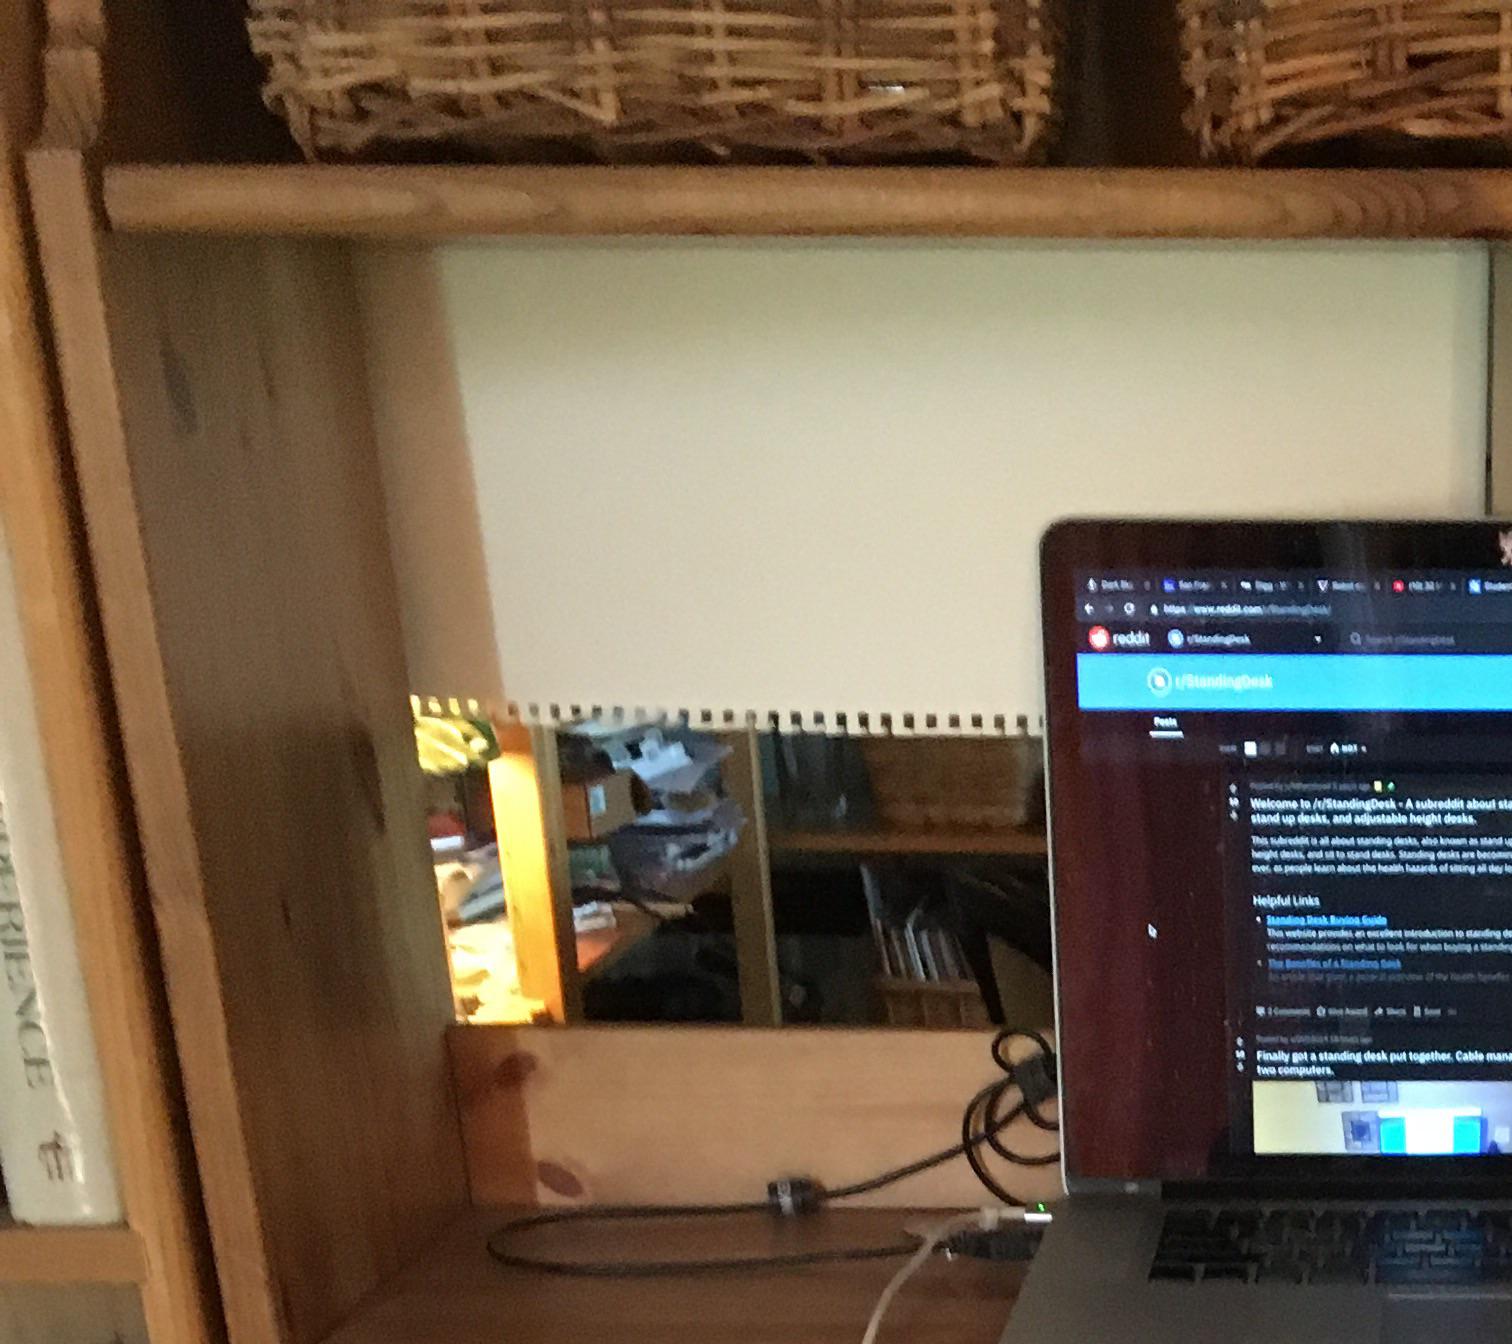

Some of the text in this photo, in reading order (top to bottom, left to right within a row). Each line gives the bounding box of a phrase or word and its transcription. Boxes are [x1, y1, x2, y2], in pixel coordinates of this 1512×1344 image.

[1112, 631, 1150, 646] reddit
[1175, 674, 1273, 691] r/StandingDesk
[1250, 798, 1299, 812] Welcome
[1300, 798, 1311, 812] to
[1312, 798, 1397, 812] /r/StandingDesk
[1405, 798, 1414, 812] A
[1415, 798, 1465, 812] subreddit
[1466, 798, 1496, 812] about
[1251, 812, 1280, 826] stand
[1282, 812, 1296, 826] up
[1332, 812, 1353, 826] and
[1354, 812, 1408, 826] adjustable
[1409, 812, 1442, 826] height
[1253, 895, 1321, 909] Helpful Links
[1256, 1051, 1290, 1064] Finally
[1291, 1051, 1309, 1064] got
[1310, 1051, 1317, 1064] a
[1318, 1051, 1362, 1064] standing
[1363, 1051, 1388, 1064] desk
[1389, 1051, 1407, 1064] put
[1455, 1051, 1485, 1064] Cable
[1256, 1065, 1277, 1078] two
